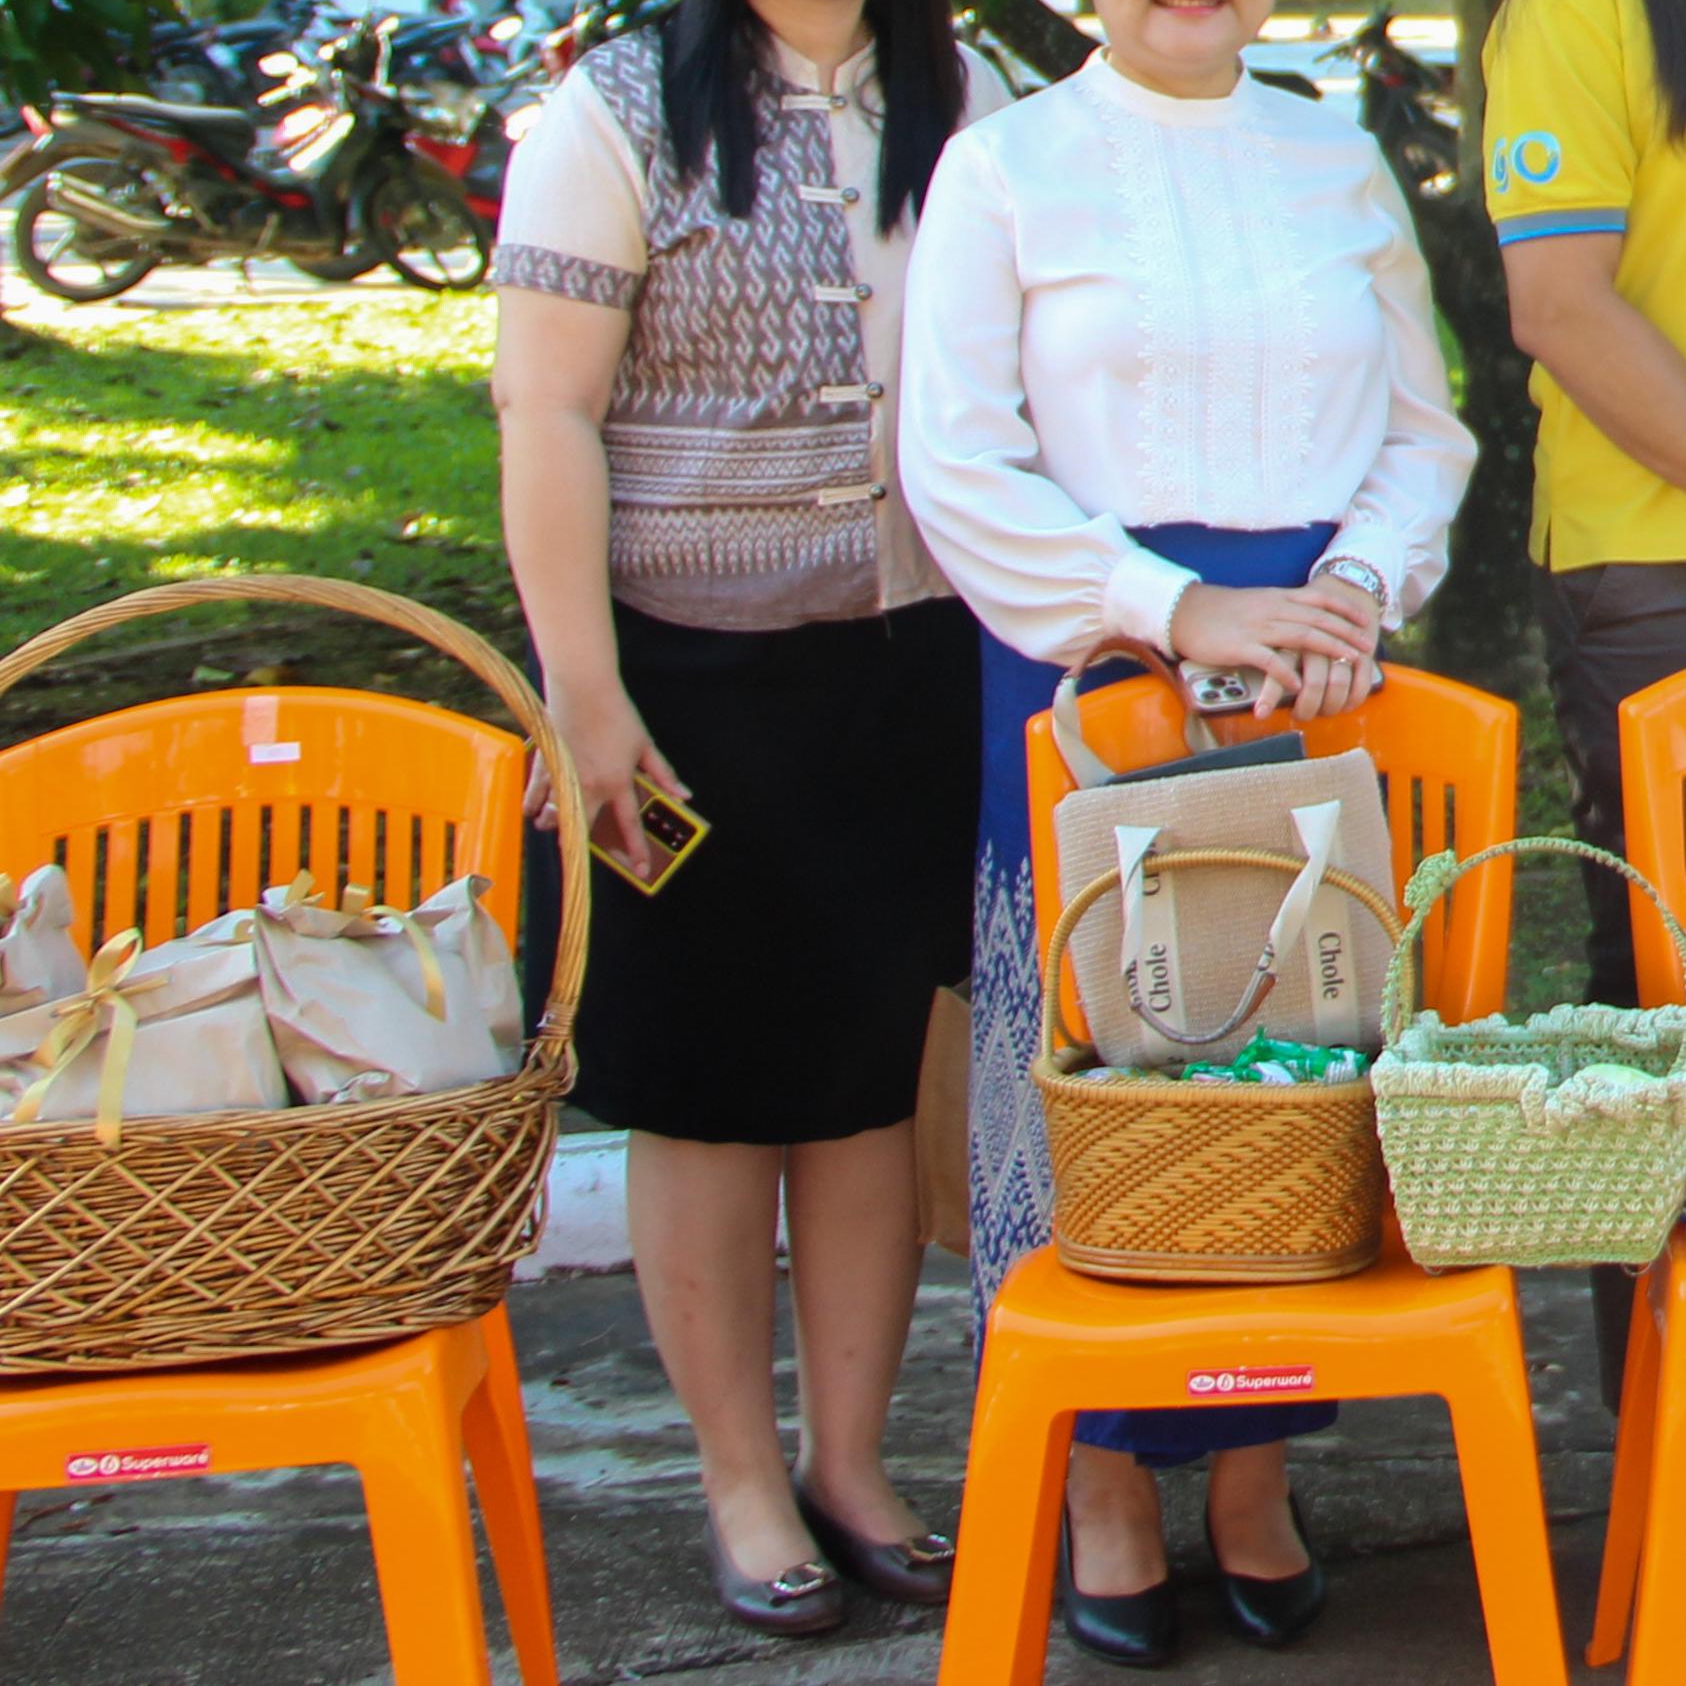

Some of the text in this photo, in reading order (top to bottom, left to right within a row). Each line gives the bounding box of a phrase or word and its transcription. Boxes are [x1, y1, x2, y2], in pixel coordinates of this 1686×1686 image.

[1146, 943, 1173, 1013] Chole
[1318, 931, 1345, 1000] Chole
[1236, 1373, 1313, 1390] Superware
[121, 1451, 210, 1471] Superware
